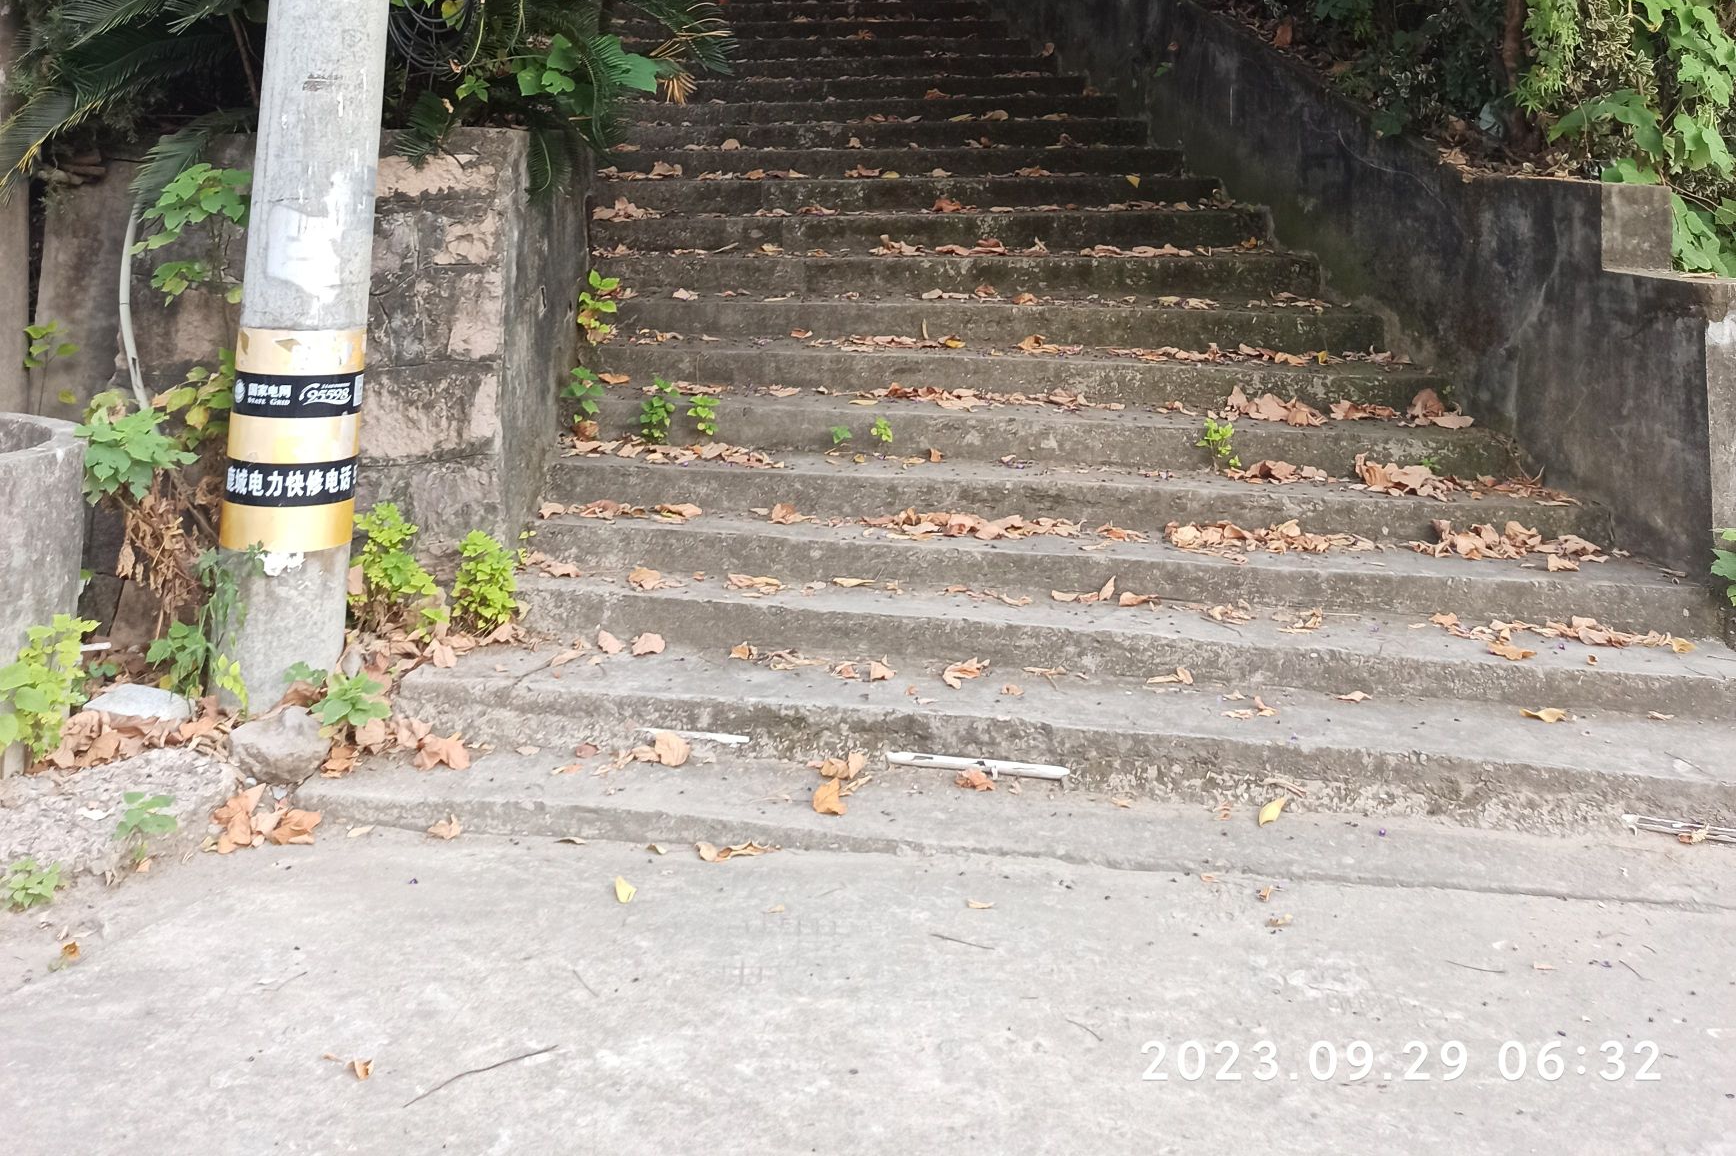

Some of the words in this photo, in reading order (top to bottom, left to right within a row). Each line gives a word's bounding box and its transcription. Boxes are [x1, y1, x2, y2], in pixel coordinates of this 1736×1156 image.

[248, 383, 292, 398] 国家电网
[306, 387, 350, 401] 95598
